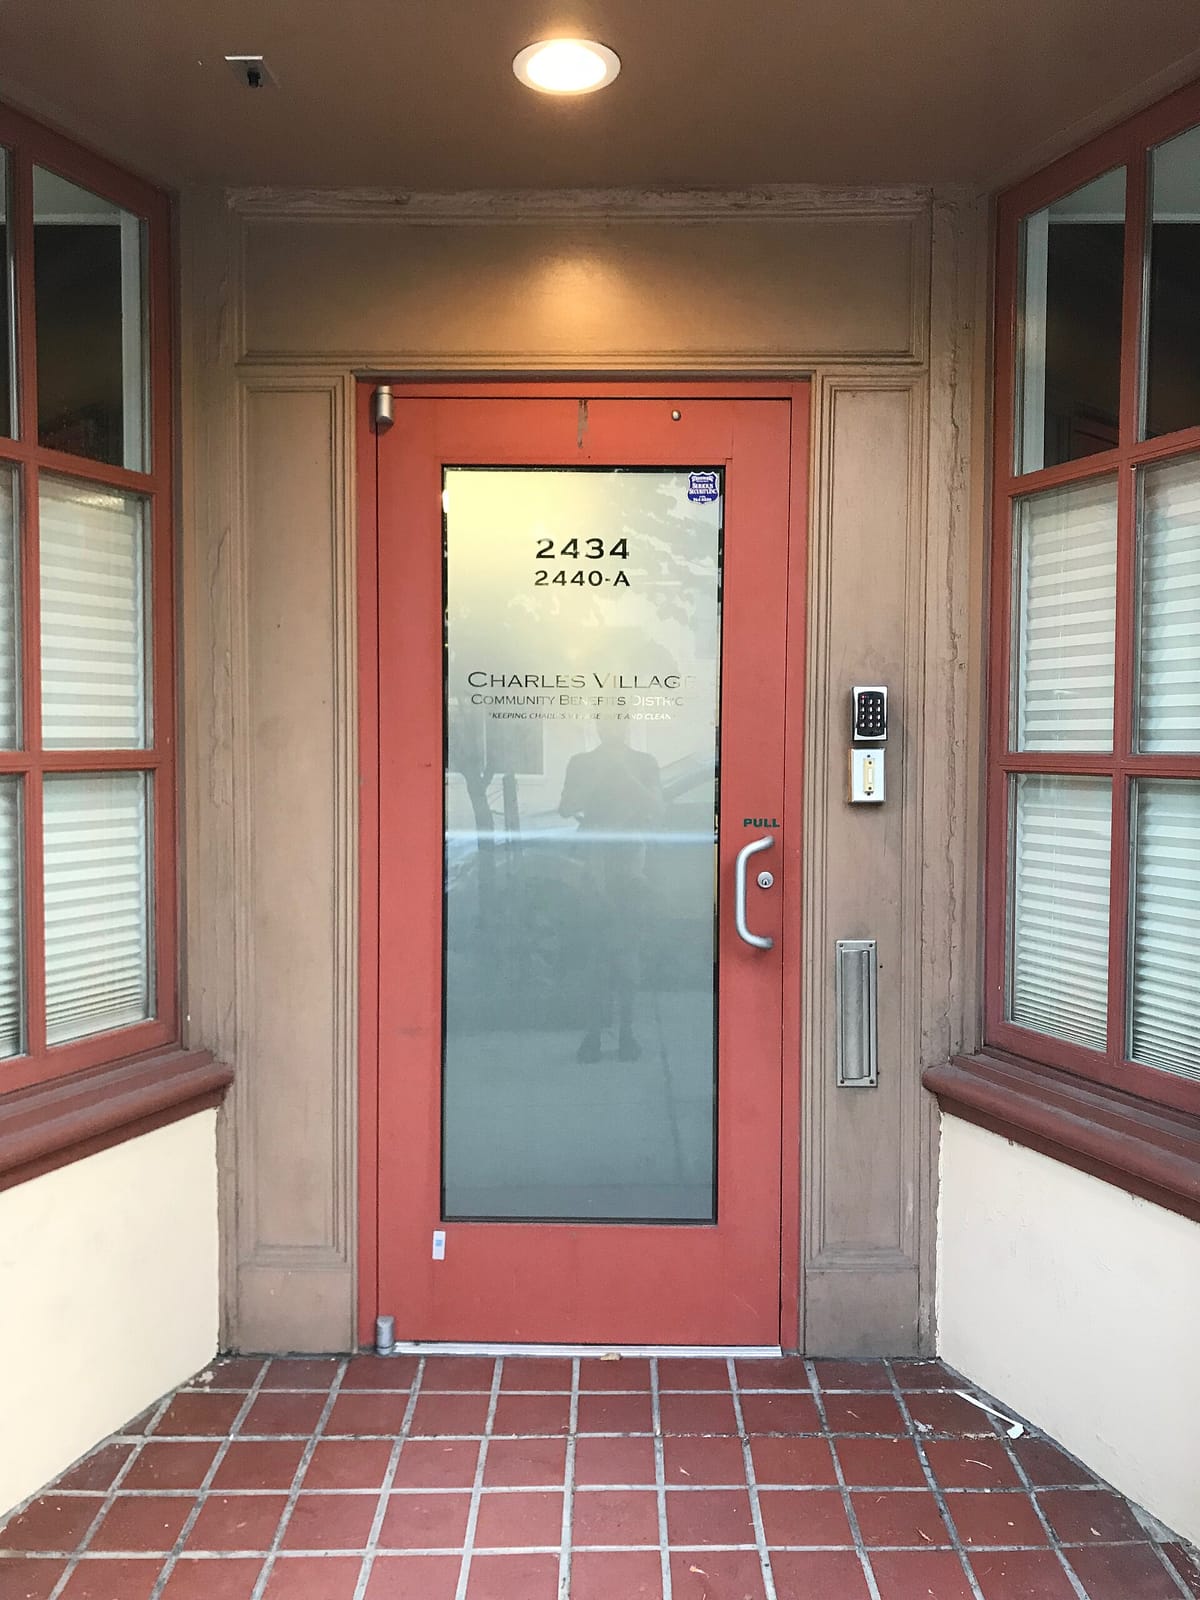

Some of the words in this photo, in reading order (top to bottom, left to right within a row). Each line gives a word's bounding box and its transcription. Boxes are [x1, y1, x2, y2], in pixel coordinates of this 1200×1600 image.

[536, 538, 630, 559] 2434
[534, 570, 631, 587] 2440-A
[467, 671, 586, 689] CHARLES
[592, 672, 697, 689] VILLAGE
[471, 693, 556, 706] COMMUNITY
[743, 818, 780, 828] PULL
